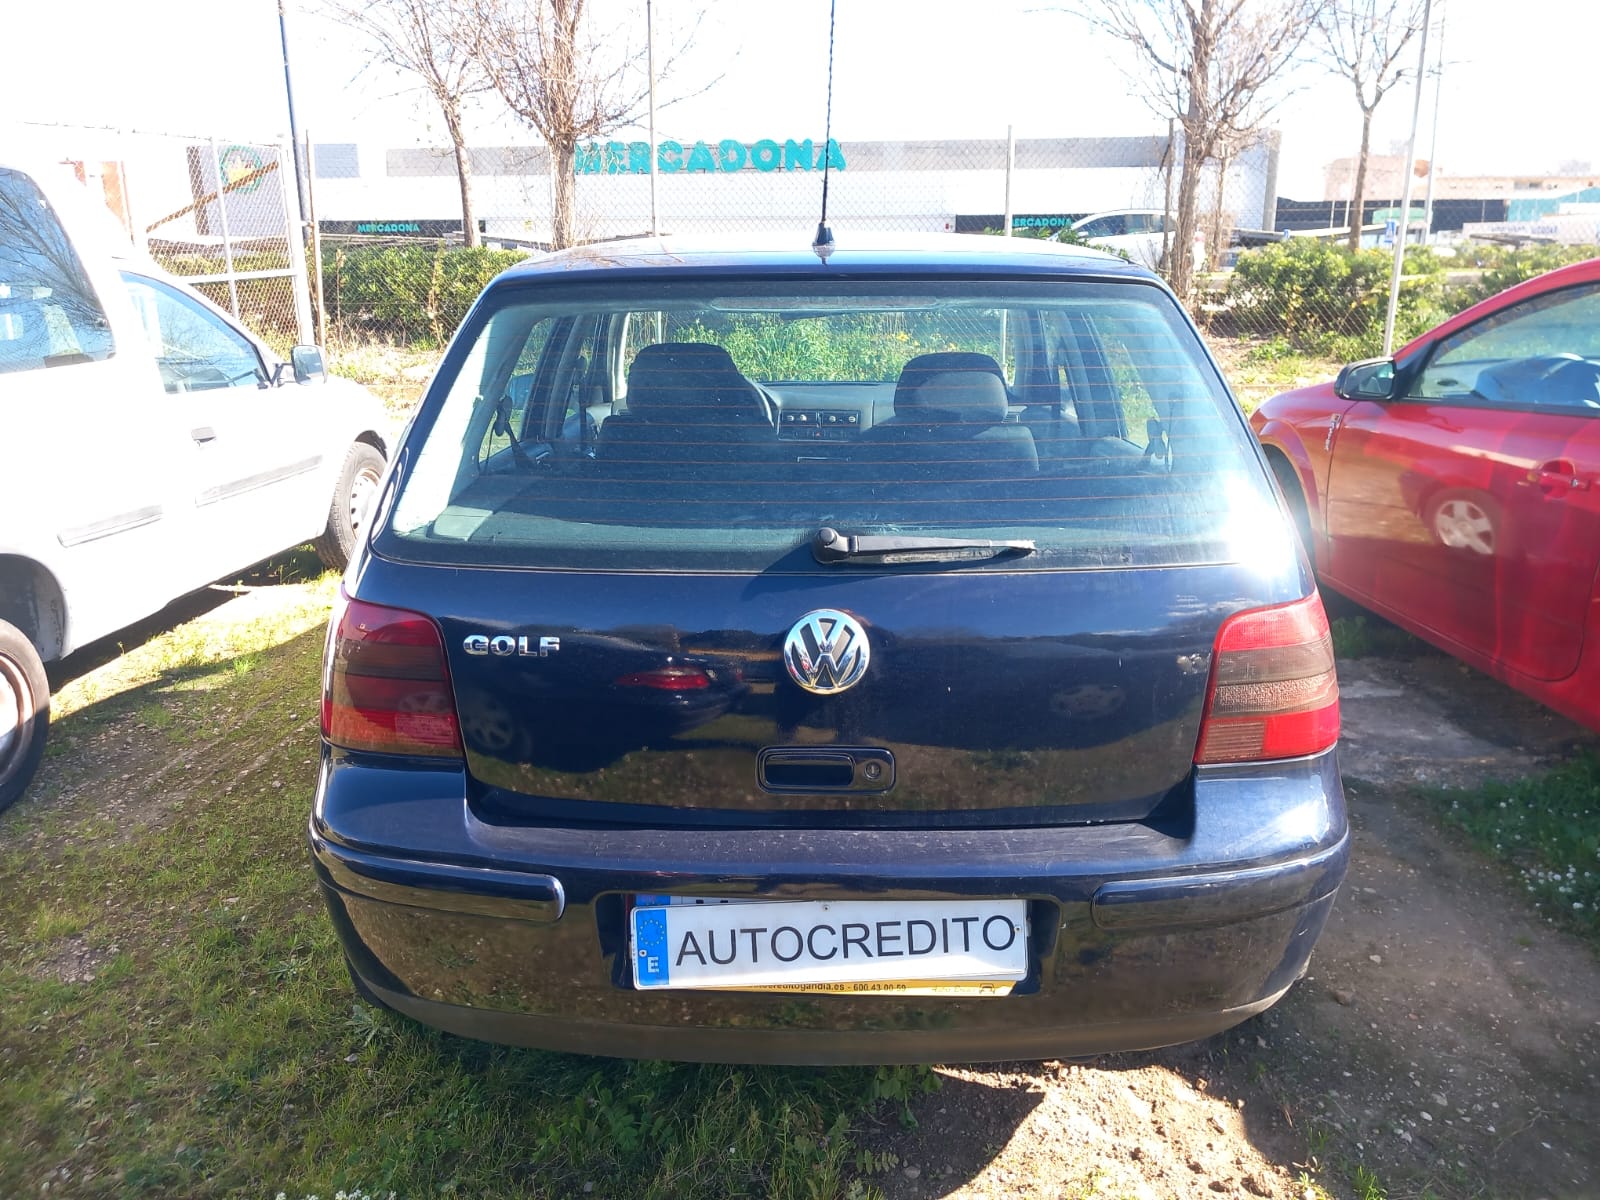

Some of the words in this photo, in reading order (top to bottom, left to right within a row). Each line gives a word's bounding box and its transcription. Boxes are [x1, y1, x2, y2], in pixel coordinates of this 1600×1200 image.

[575, 139, 846, 174] MERCADONA
[358, 223, 419, 233] MERCADONA
[1012, 218, 1071, 227] ERCADONA
[463, 634, 560, 657] GOLF
[675, 914, 1016, 967] AUTOCREDITO
[647, 956, 660, 973] E
